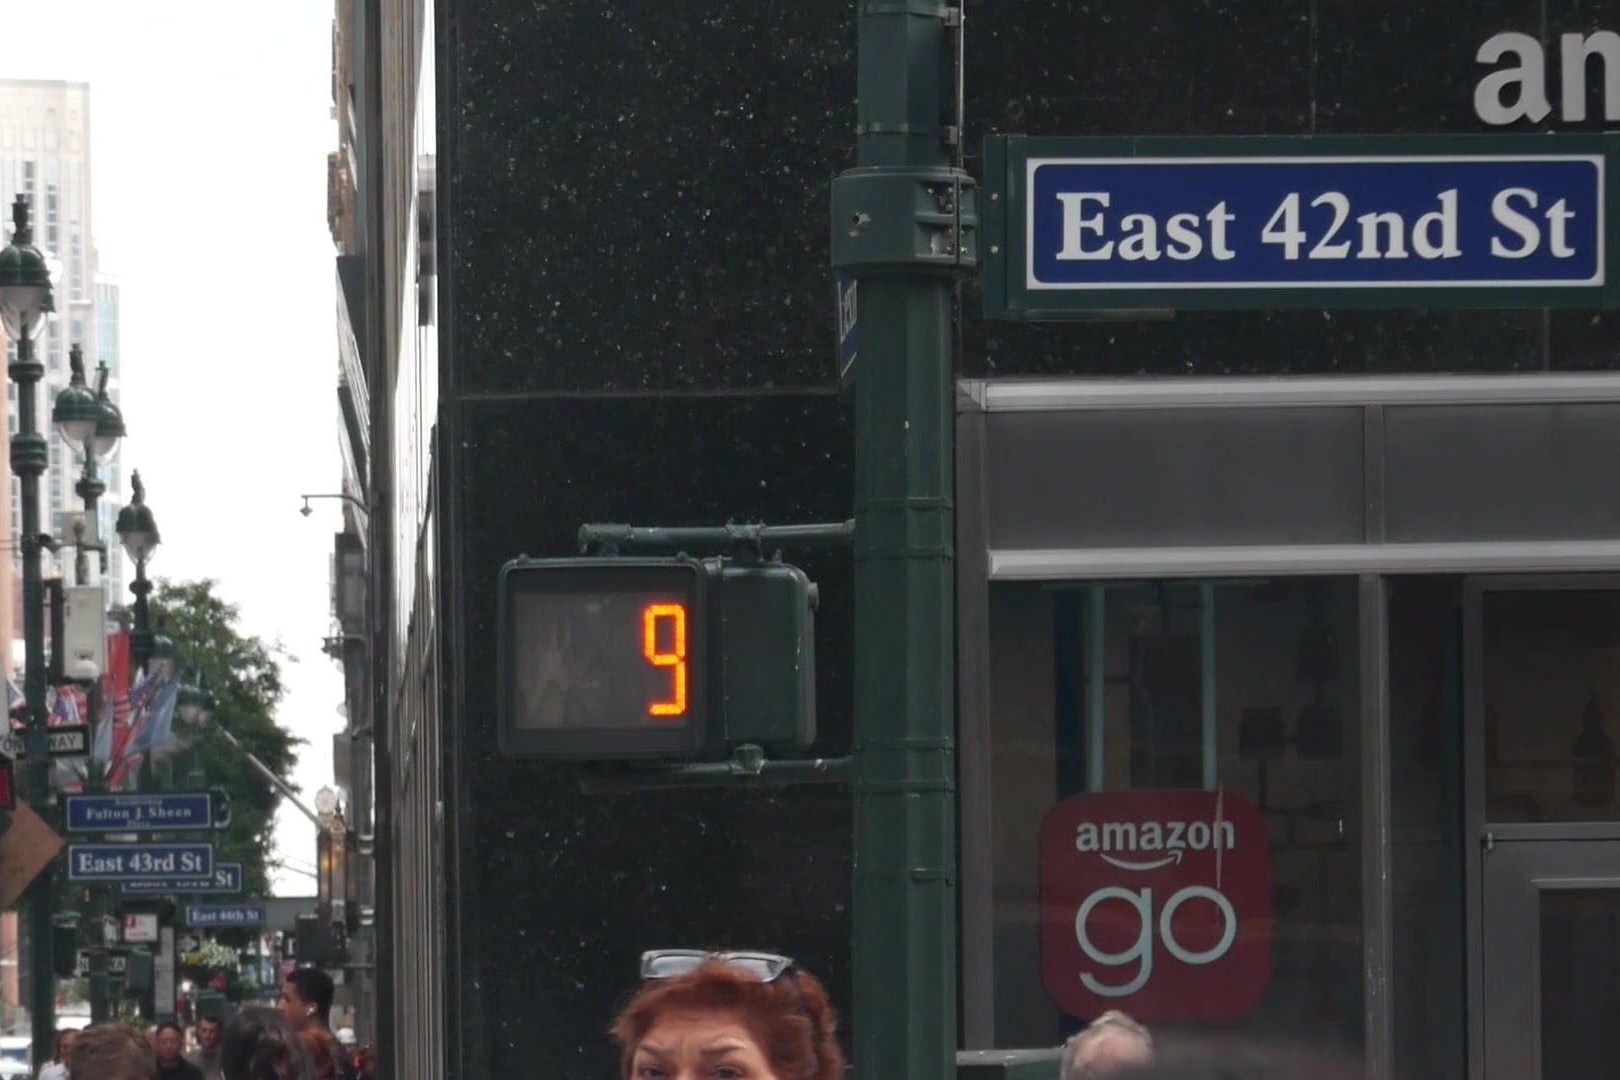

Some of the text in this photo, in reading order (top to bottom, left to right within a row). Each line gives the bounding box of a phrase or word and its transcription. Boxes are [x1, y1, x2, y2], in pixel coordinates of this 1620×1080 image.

[1055, 187, 1576, 261] East 42nd St
[644, 604, 686, 716] 9
[86, 807, 130, 820] Fulton
[148, 806, 192, 818] Sheen
[1075, 820, 1235, 851] amazon
[78, 851, 203, 872] East 43rd St
[215, 870, 233, 886] St
[192, 910, 217, 921] East
[246, 909, 260, 920] St
[1075, 885, 1237, 997] go
